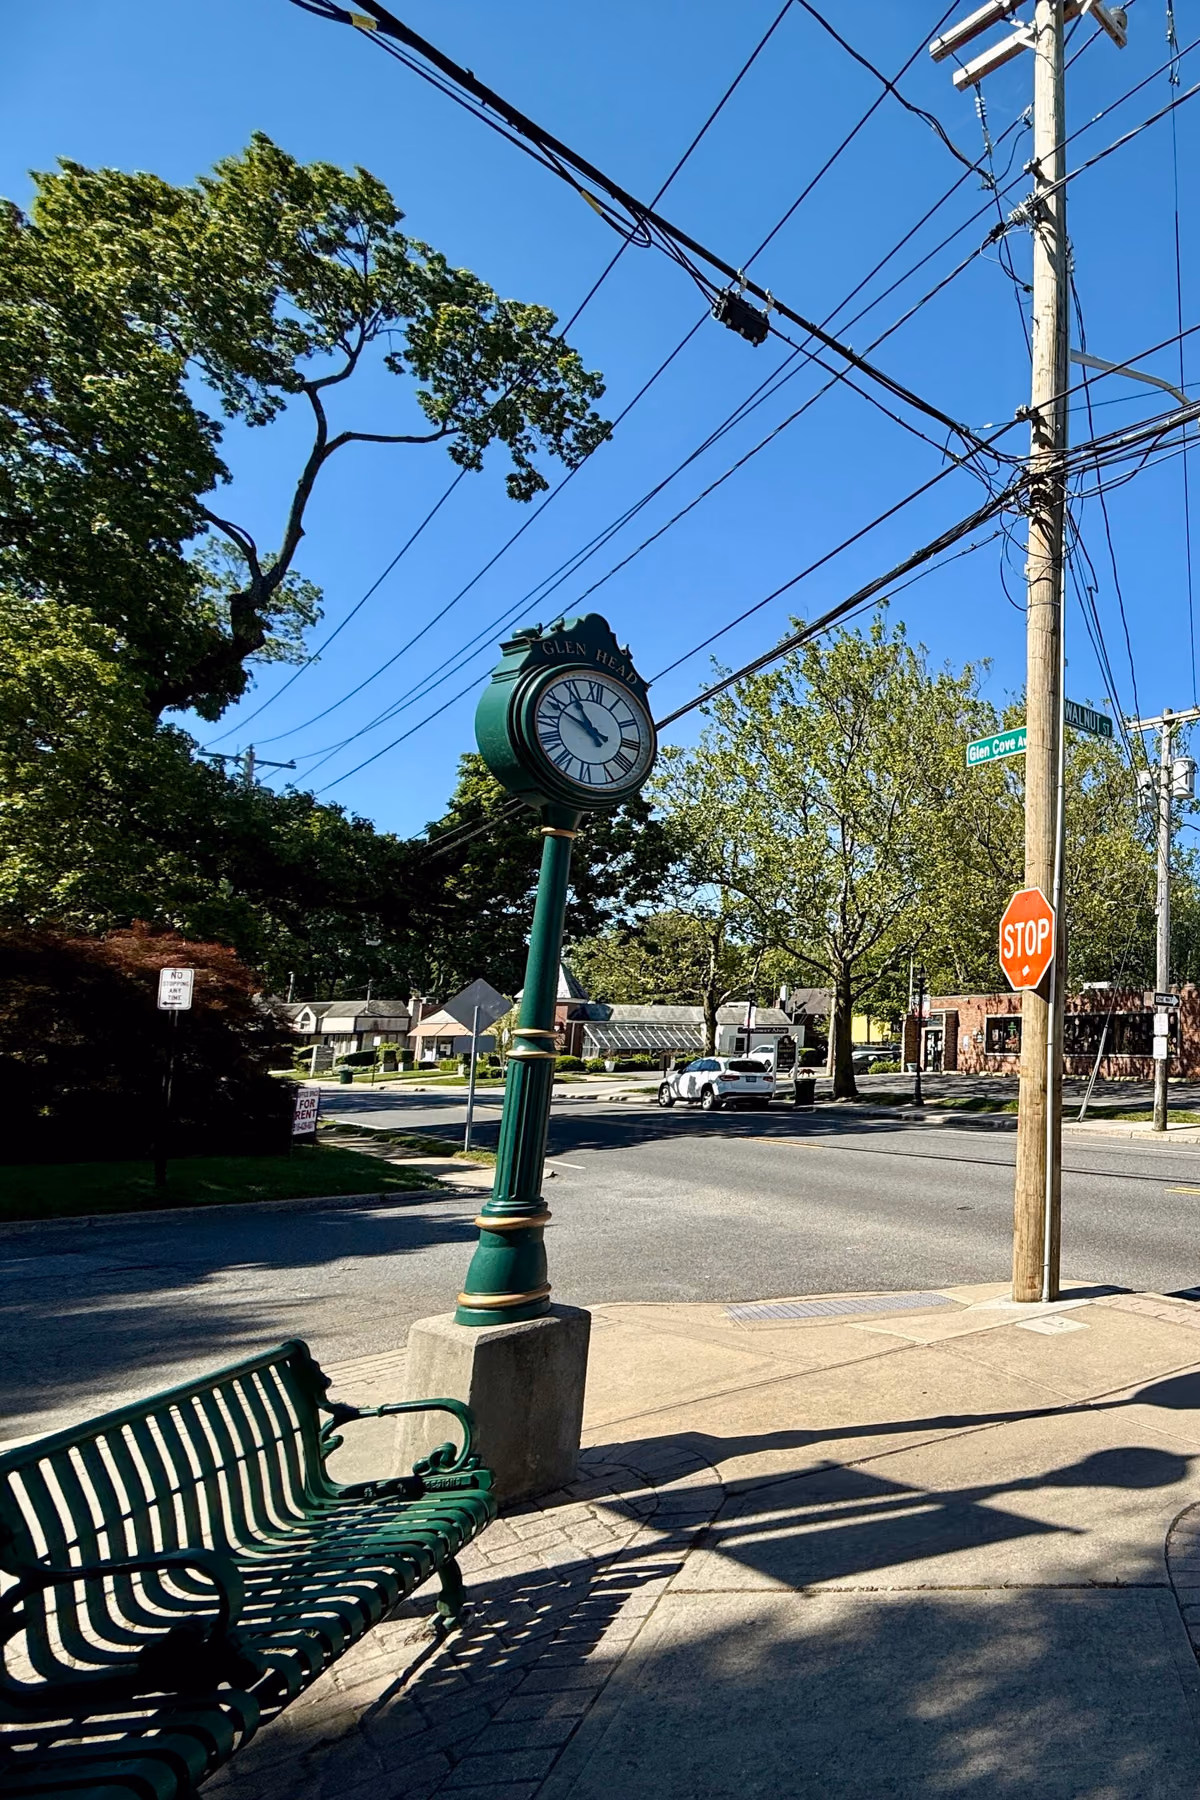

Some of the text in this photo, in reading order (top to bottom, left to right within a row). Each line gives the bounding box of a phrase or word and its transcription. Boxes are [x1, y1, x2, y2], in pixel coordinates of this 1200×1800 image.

[542, 640, 638, 685] GLEN HEAD
[1065, 702, 1111, 737] WALNUT ST
[969, 745, 990, 761] Glen
[992, 738, 1016, 755] Cove
[1004, 918, 1050, 959] STOP
[295, 1110, 317, 1120] RENT
[300, 1099, 315, 1109] FOR
